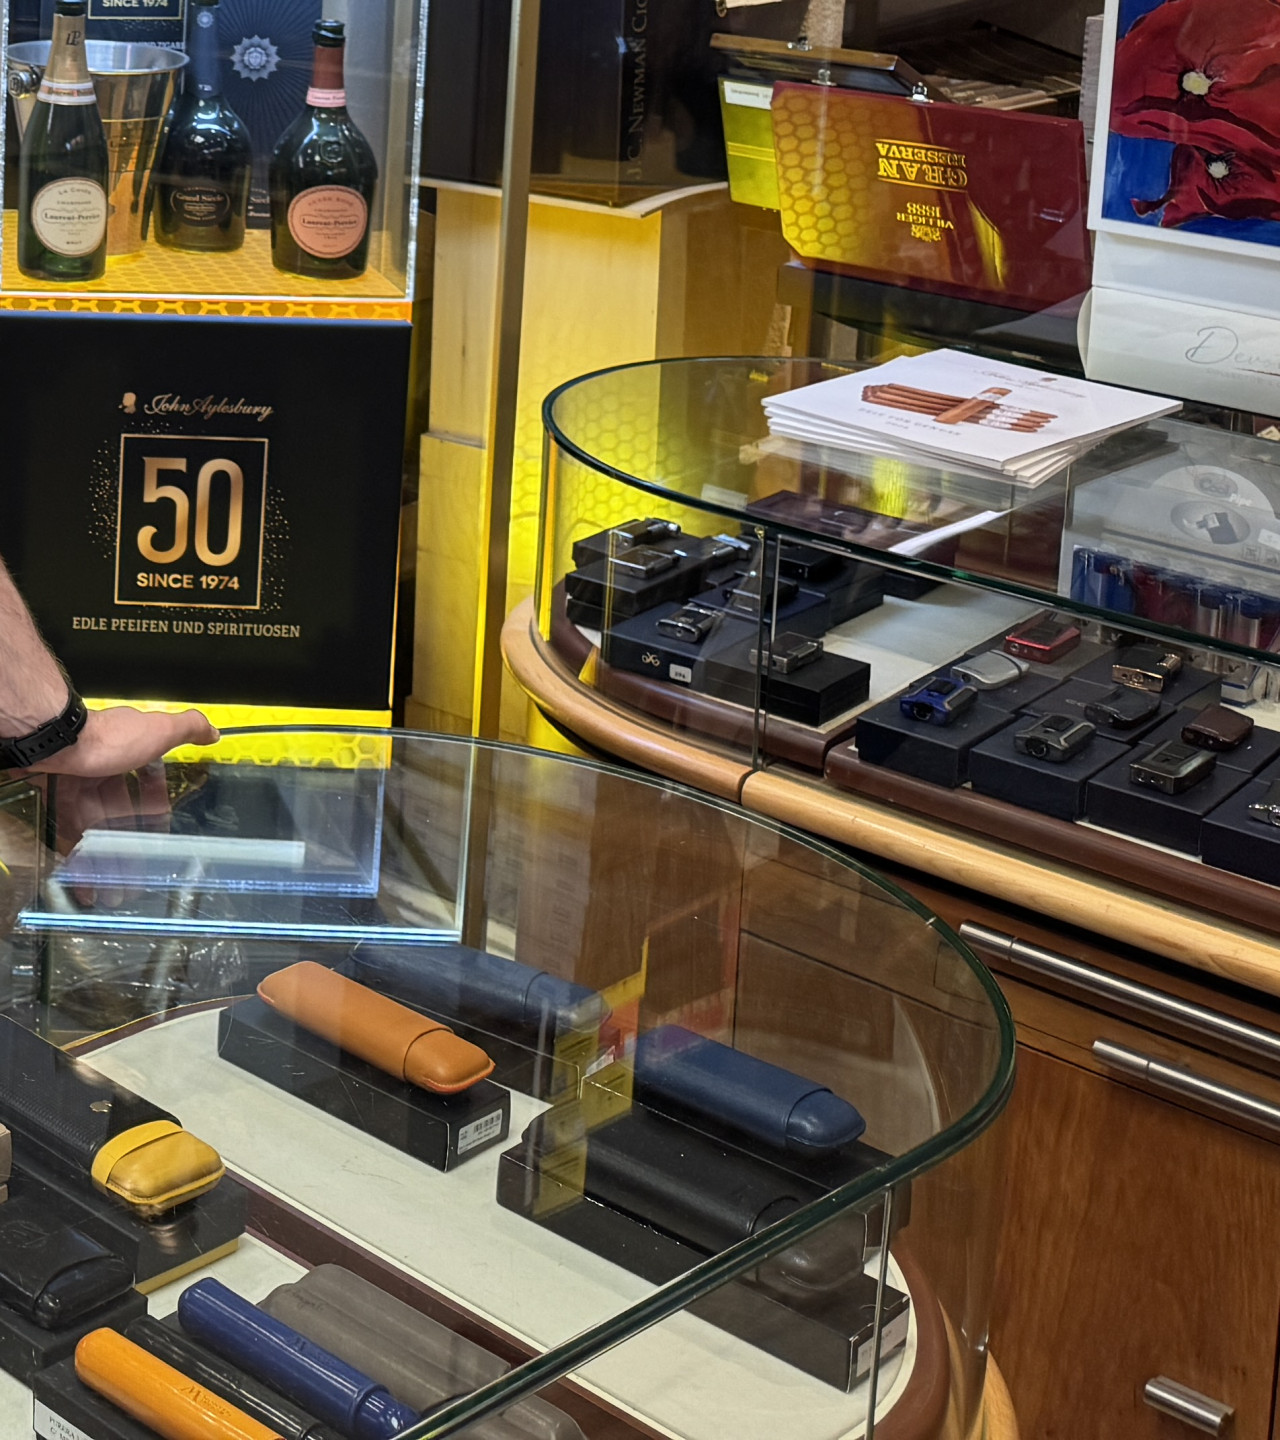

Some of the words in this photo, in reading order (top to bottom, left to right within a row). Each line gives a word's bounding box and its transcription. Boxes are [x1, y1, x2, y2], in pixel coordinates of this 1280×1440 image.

[875, 141, 967, 168] RESERVA
[877, 157, 968, 187] GRAN
[906, 201, 942, 218] 1888
[144, 393, 192, 416] John
[187, 394, 274, 422] Aylesbury
[137, 455, 244, 567] 50
[136, 572, 194, 589] SINCE
[199, 574, 240, 590] 1974
[72, 616, 108, 631] EDLE
[111, 617, 169, 634] PFEIFEN
[172, 620, 205, 635] UND
[207, 621, 301, 639] SPIRITUOSEN
